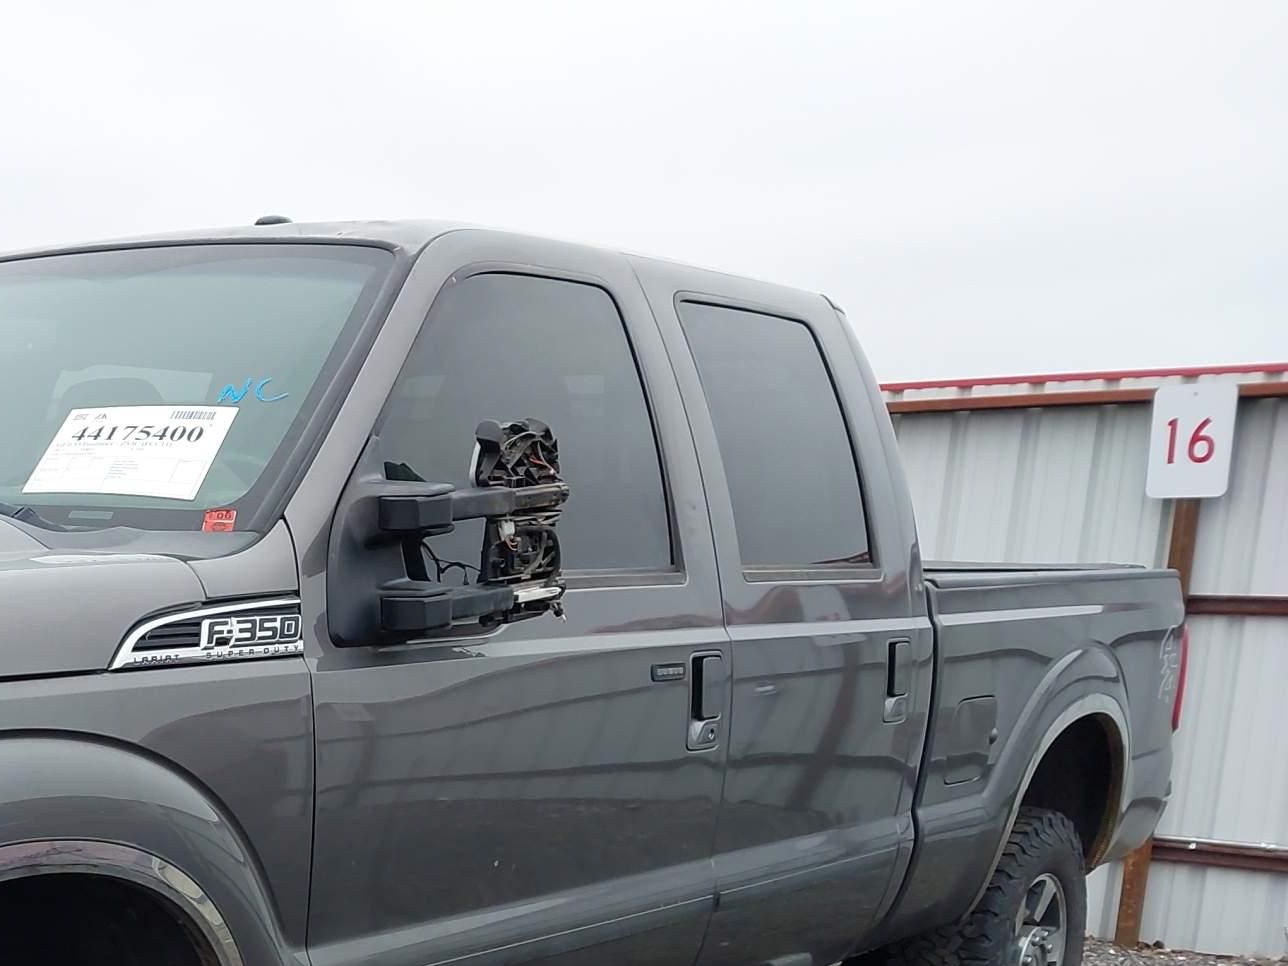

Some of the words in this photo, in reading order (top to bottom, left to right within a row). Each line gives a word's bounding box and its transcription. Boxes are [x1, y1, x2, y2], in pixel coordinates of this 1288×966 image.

[217, 377, 289, 404] NC
[72, 424, 205, 443] 44175400
[1166, 416, 1215, 465] 16
[202, 615, 301, 649] F-350
[133, 654, 180, 665] LARIAT
[206, 648, 256, 659] SUPER
[263, 644, 300, 656] DUTY
